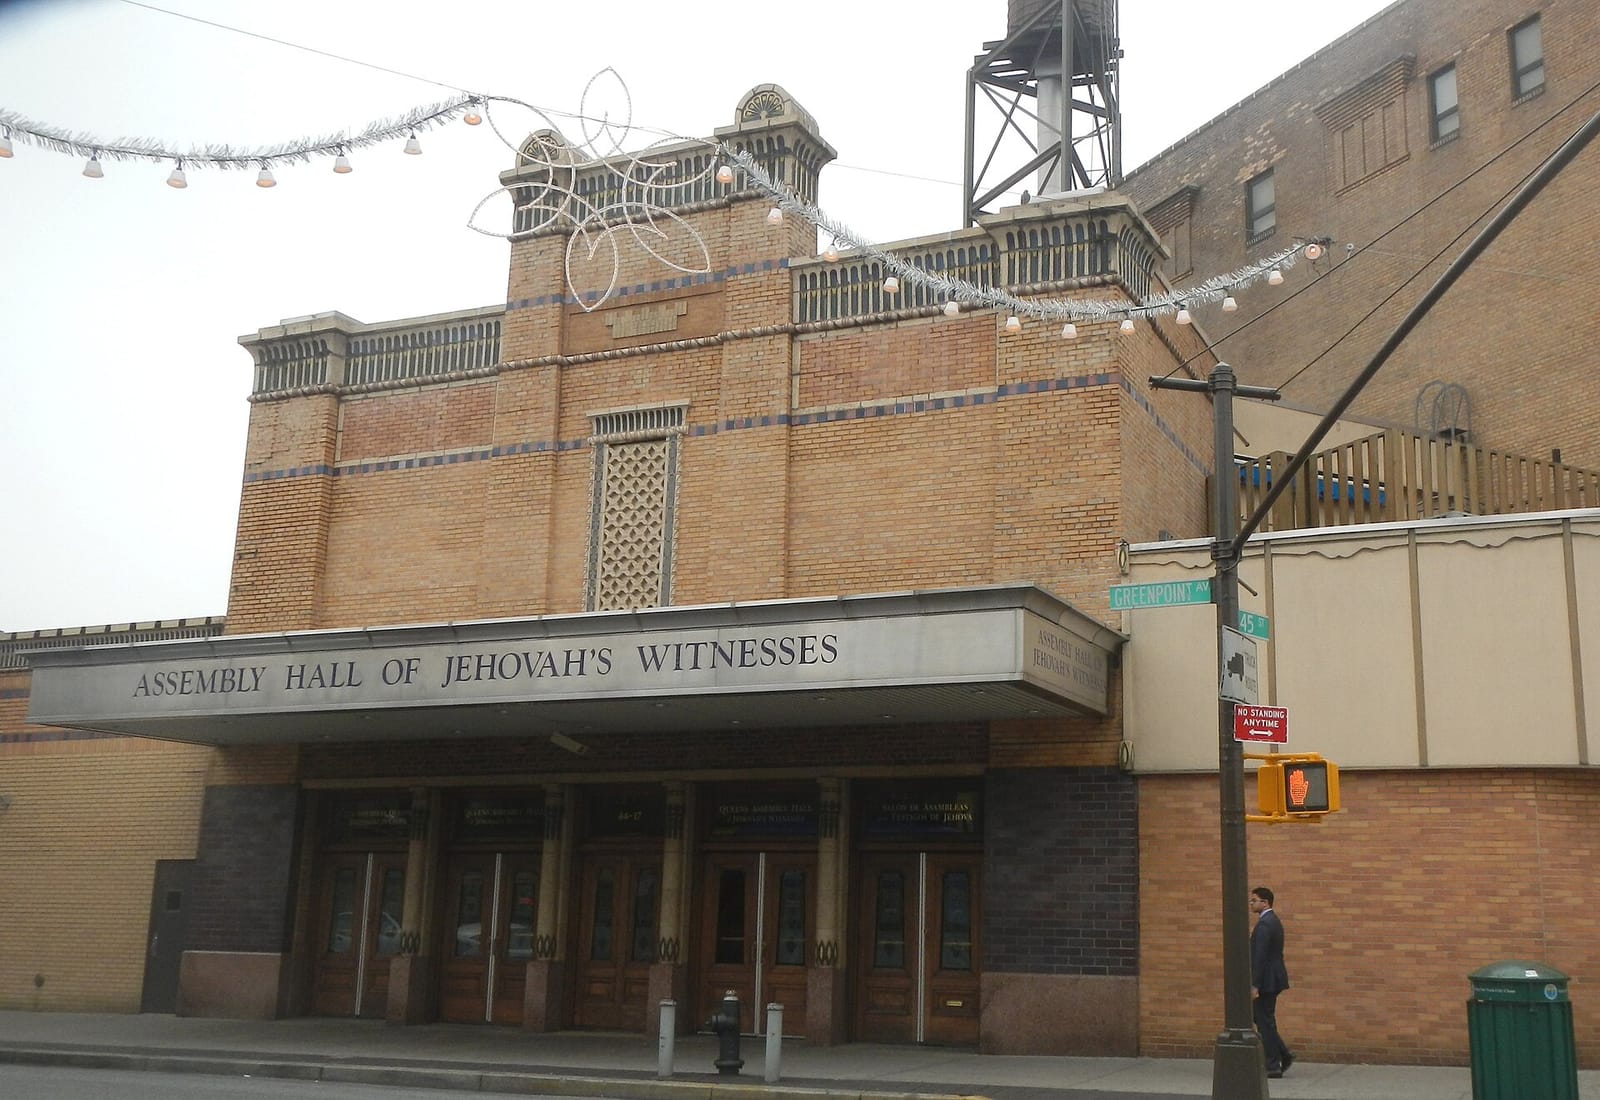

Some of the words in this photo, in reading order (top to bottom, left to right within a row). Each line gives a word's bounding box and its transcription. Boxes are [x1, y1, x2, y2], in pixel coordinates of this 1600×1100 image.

[1114, 582, 1193, 607] GREENPOINT
[1195, 581, 1209, 592] AV
[1239, 613, 1254, 633] 45
[1258, 617, 1265, 627] ST
[133, 666, 268, 698] ASSEMBLY
[285, 661, 362, 690] HALL
[382, 657, 421, 686] OF
[441, 647, 613, 688] JEHOVAH'S
[637, 634, 839, 673] WITNESSES
[1237, 707, 1248, 717] NO
[1250, 708, 1285, 719] STANDING
[1243, 718, 1280, 728] ANYTIME
